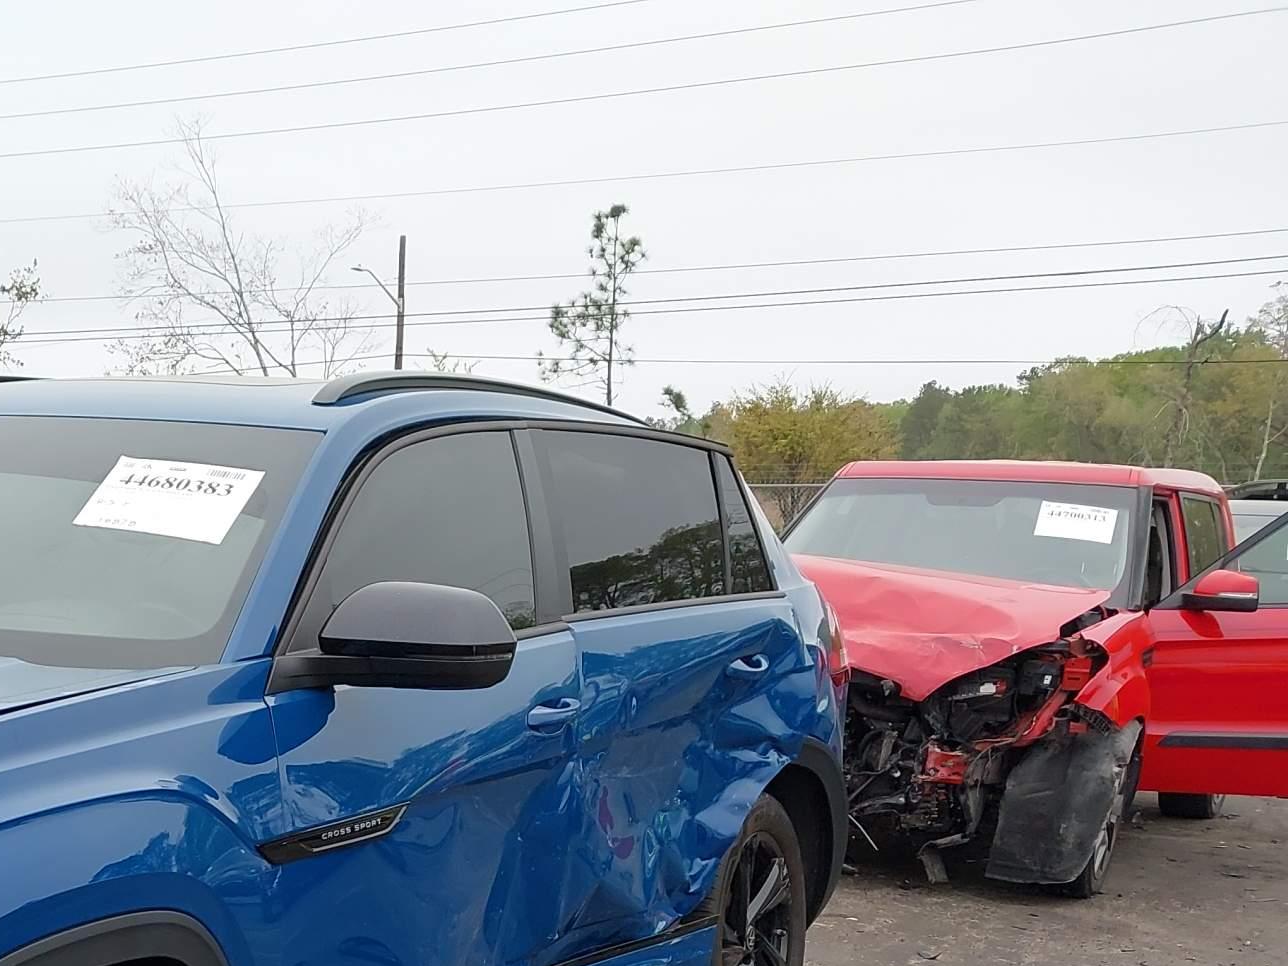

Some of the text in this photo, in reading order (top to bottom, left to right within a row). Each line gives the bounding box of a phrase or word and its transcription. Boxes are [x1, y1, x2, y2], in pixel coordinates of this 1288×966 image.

[119, 473, 235, 497] 44680383
[321, 818, 382, 840] CROSS SPORT
